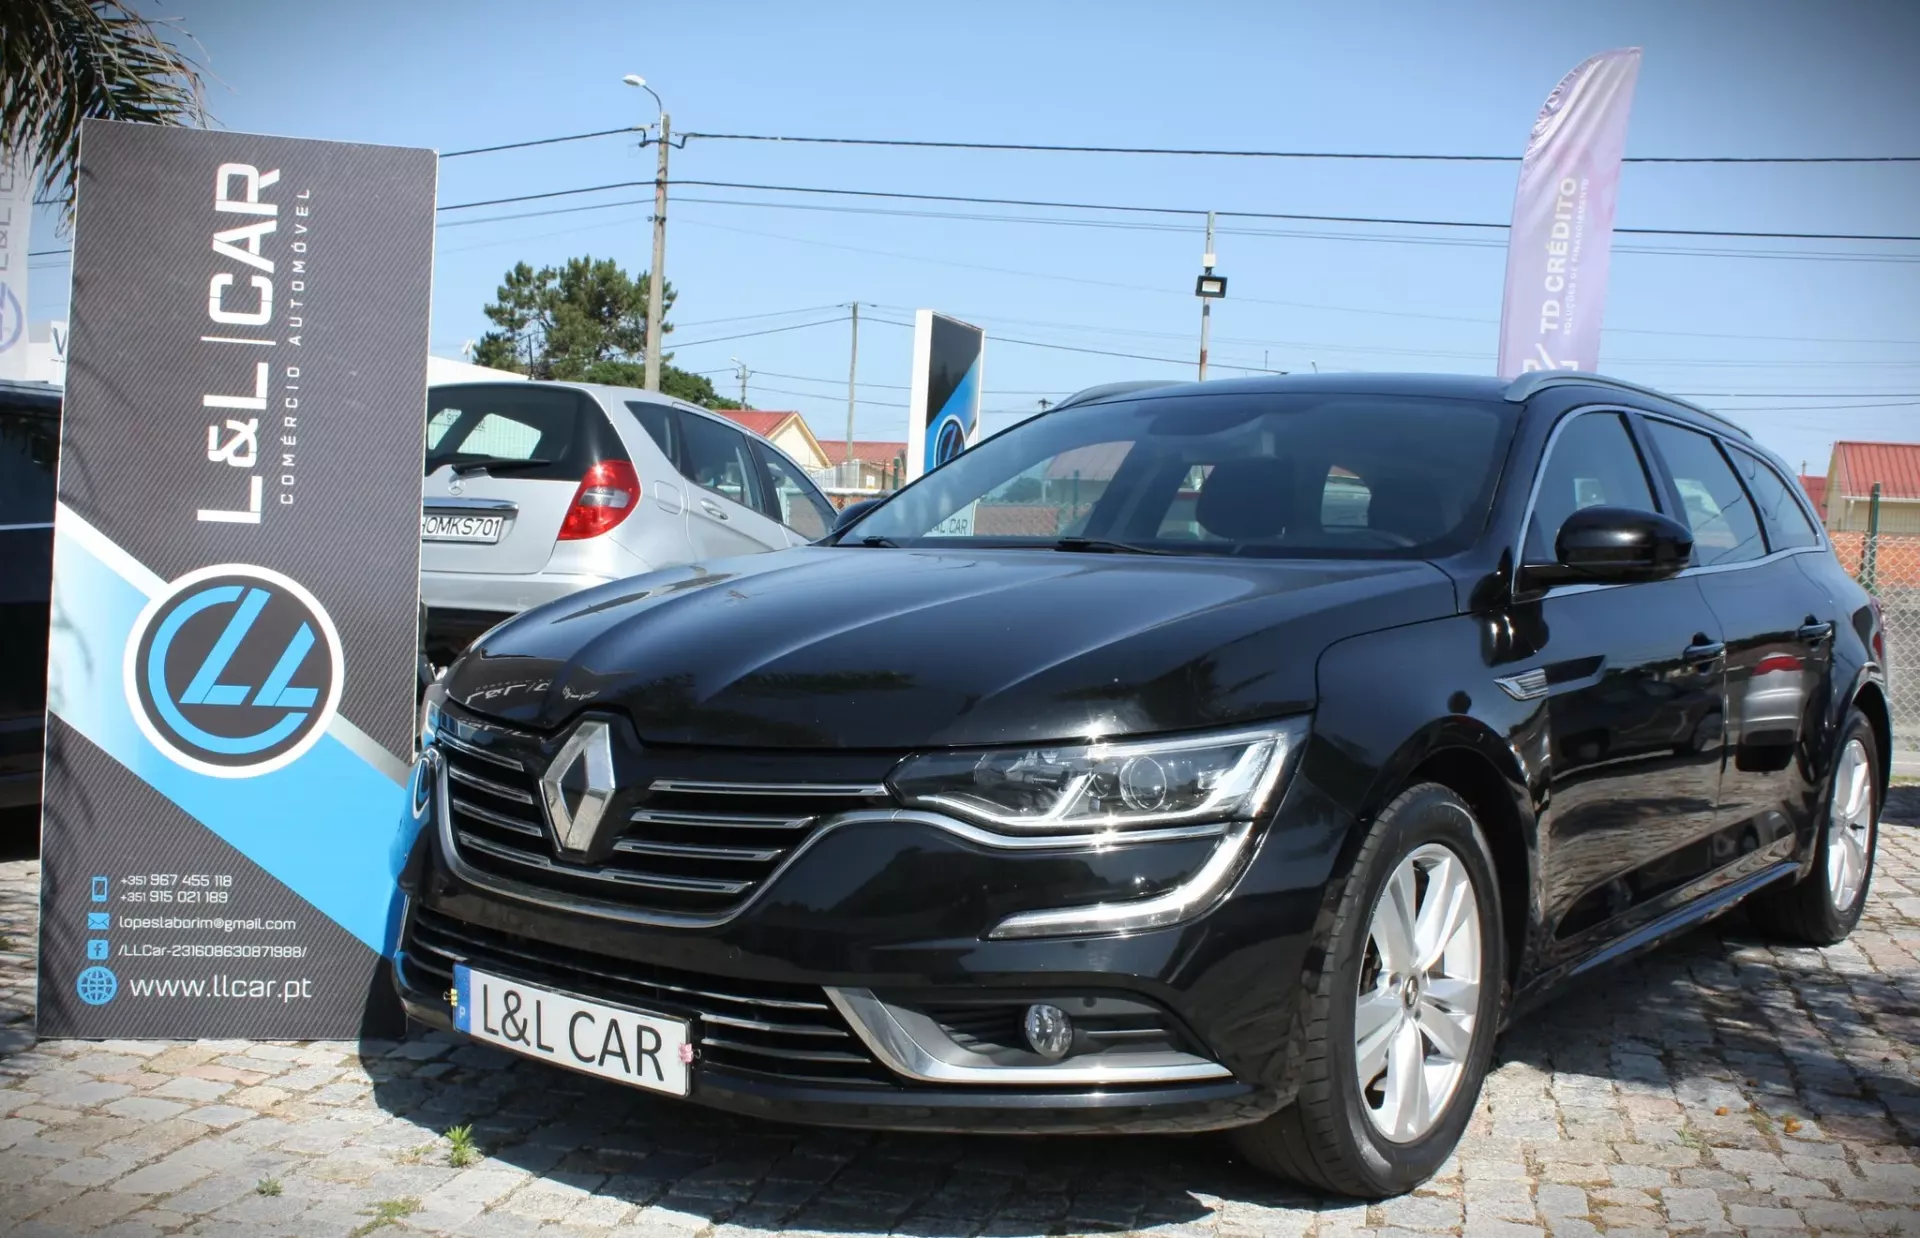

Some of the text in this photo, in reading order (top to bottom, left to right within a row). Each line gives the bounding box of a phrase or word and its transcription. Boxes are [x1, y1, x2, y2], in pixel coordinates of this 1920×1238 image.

[1544, 177, 1578, 293] CRÉDITO
[1540, 300, 1561, 334] TD
[197, 162, 281, 524] L&L CAR
[280, 188, 311, 505] COMÉRCIO AUTOMÓVEL
[120, 874, 233, 887] +351 967 455 118
[120, 891, 229, 904] +351 915 021 189
[119, 916, 296, 932] lopeslaborim@gmail.com
[129, 974, 313, 1003] www.llcar.pt
[483, 984, 555, 1053] L&L
[568, 1010, 665, 1082] CAR
